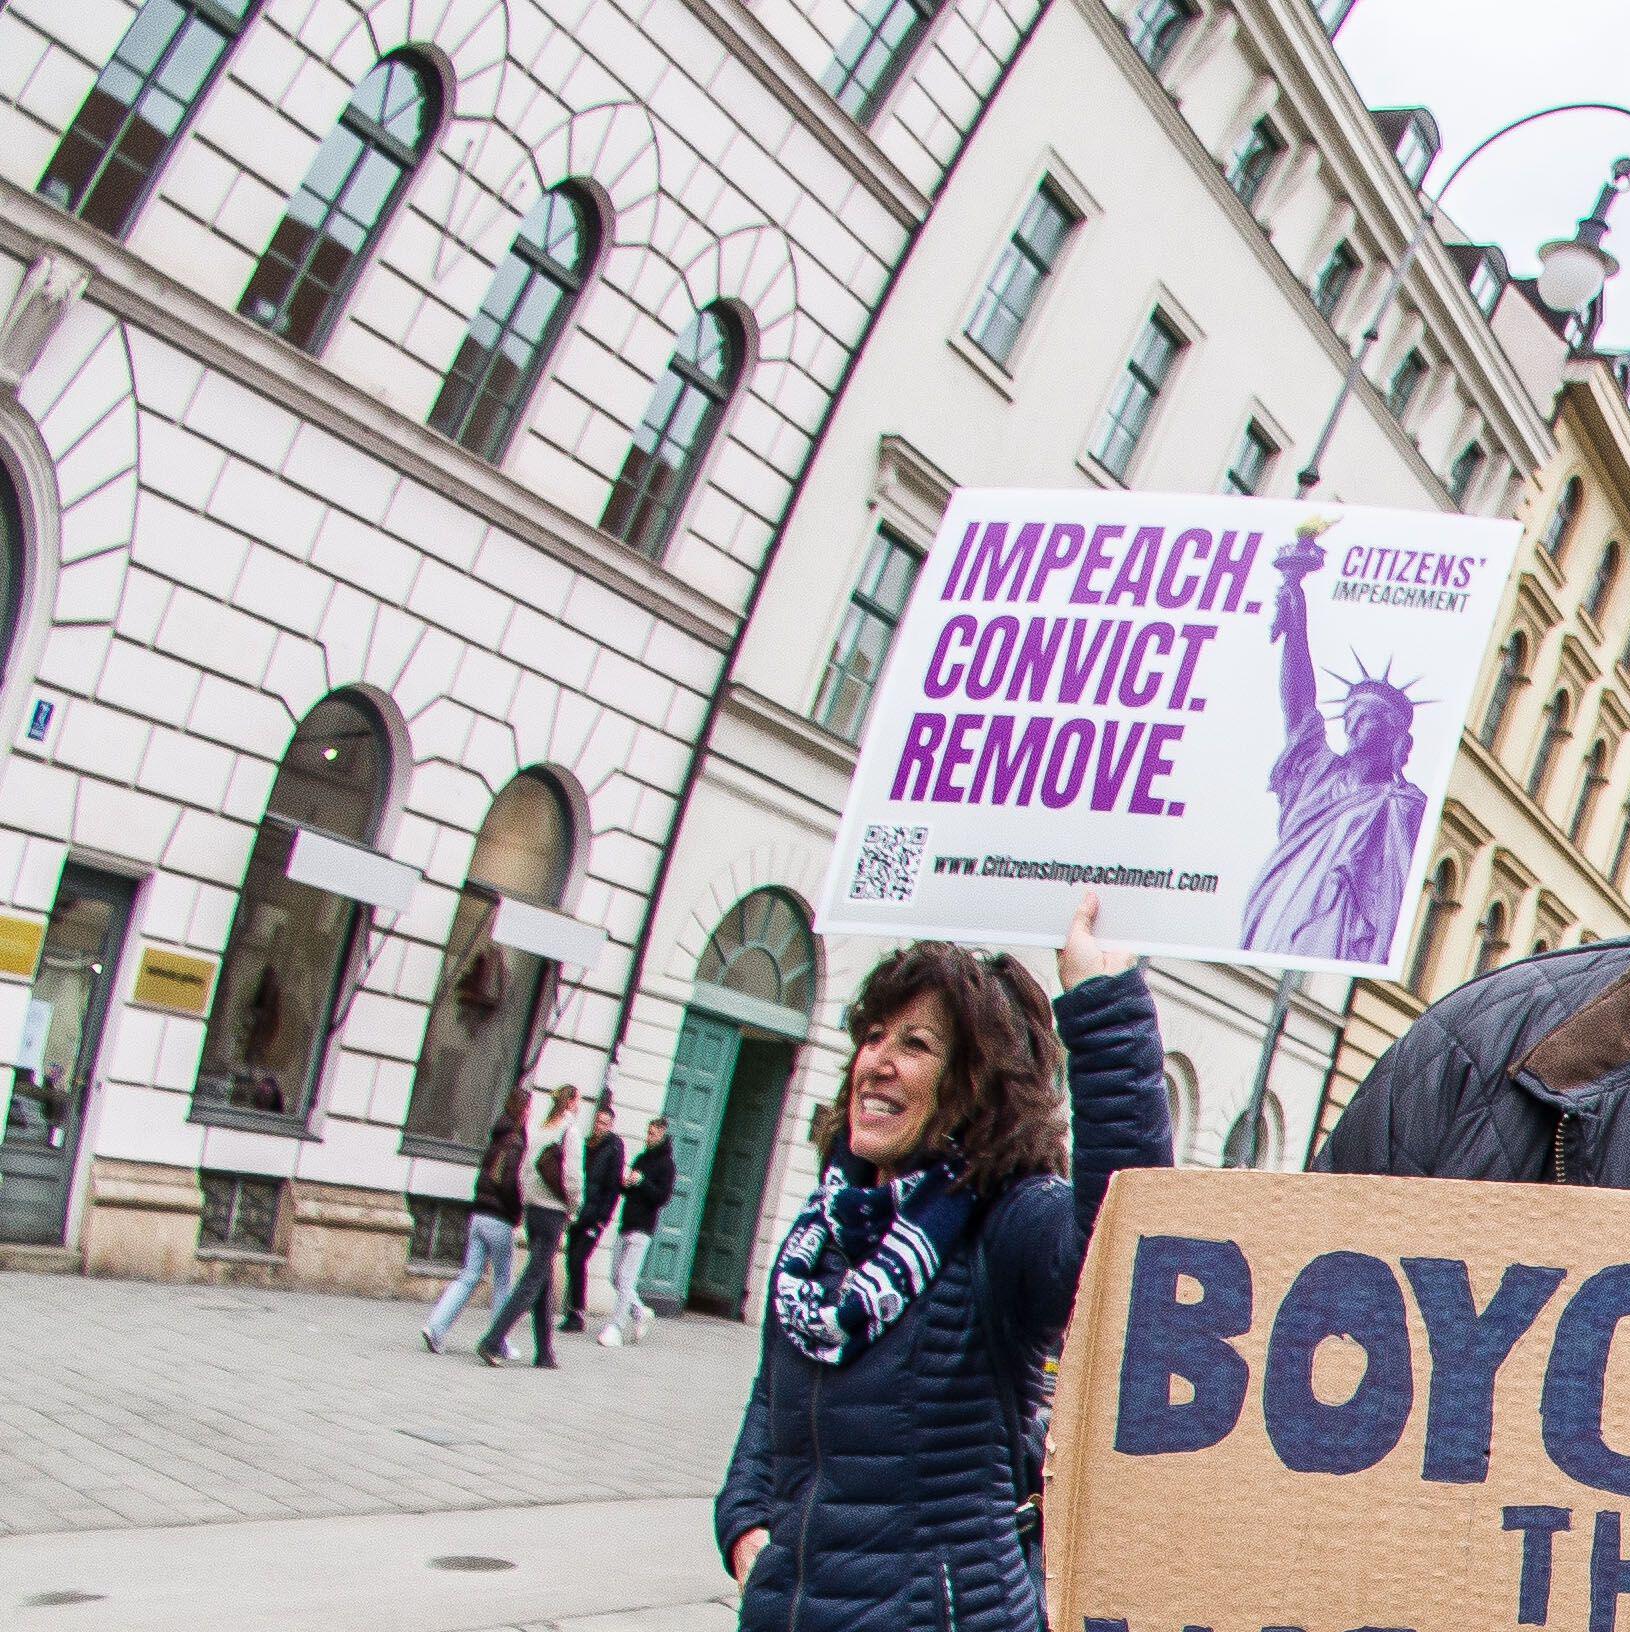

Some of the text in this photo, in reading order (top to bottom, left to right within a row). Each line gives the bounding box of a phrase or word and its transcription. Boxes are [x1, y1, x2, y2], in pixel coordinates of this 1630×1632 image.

[941, 522, 1264, 615] IMPEACH.
[1331, 581, 1471, 613] IMPEACHMENT
[924, 615, 1218, 713] CONVICT.
[890, 713, 1186, 818] REMOVE.
